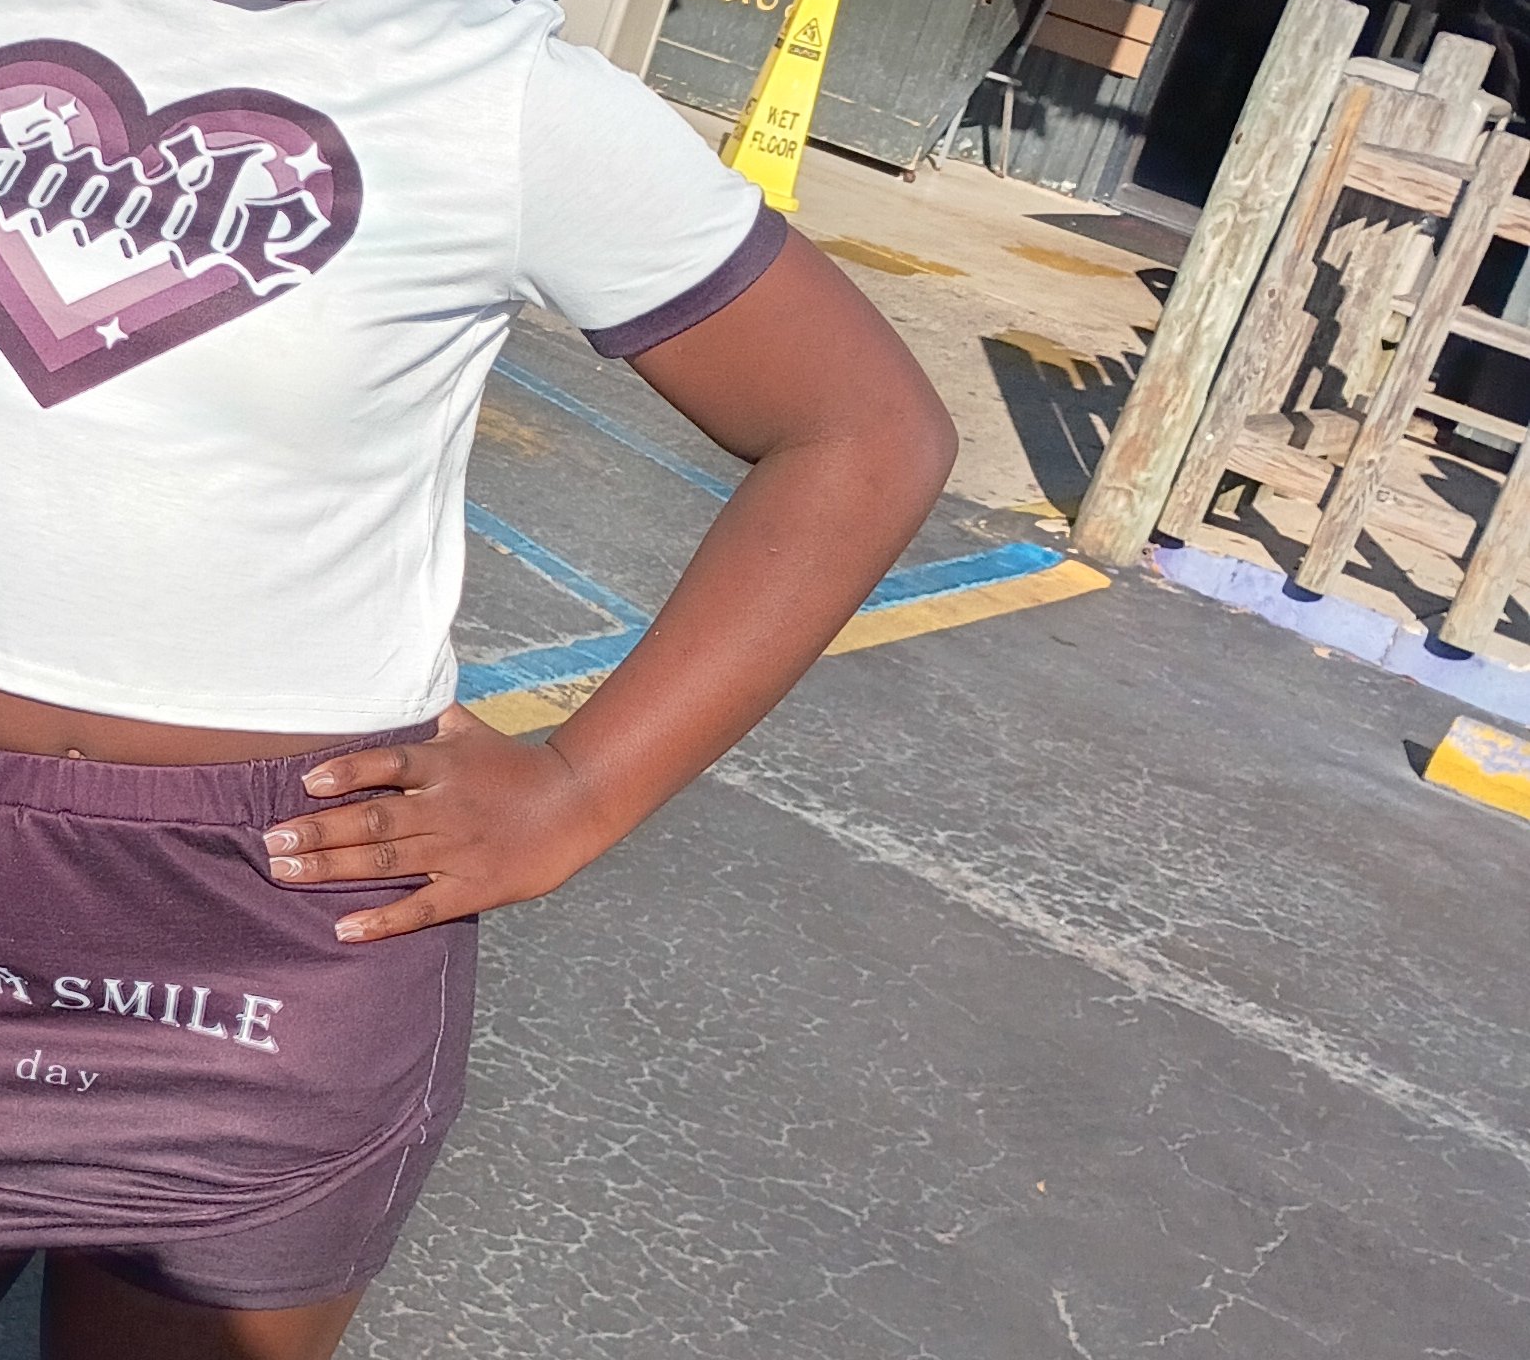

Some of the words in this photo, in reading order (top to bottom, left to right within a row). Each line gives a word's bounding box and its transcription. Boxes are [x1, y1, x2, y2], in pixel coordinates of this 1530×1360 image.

[766, 105, 801, 132] WET
[749, 130, 798, 160] FLOOR
[50, 975, 285, 1056] SMILE
[15, 1048, 101, 1093] day
